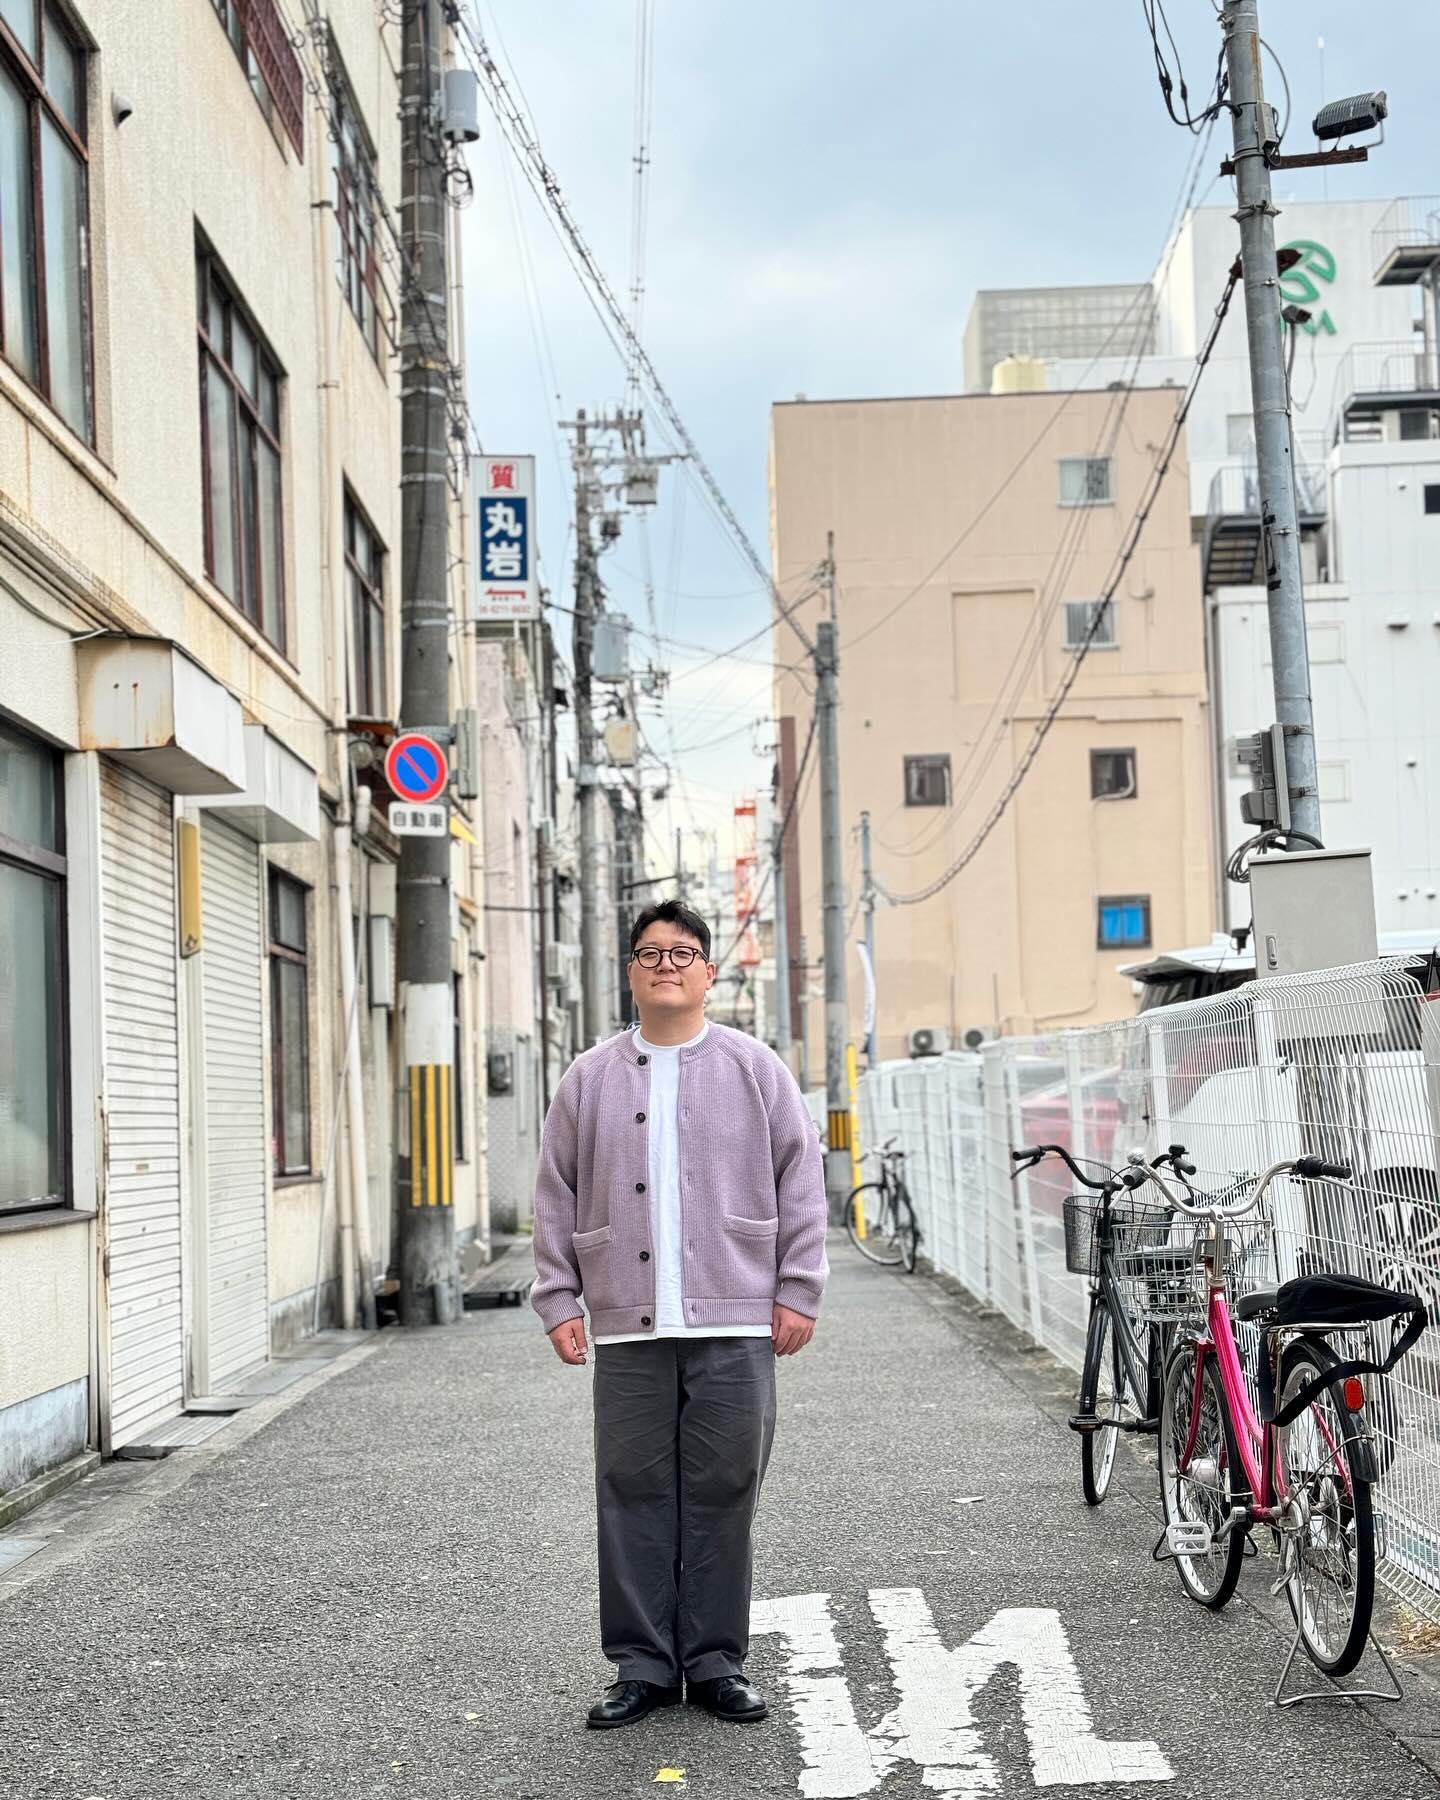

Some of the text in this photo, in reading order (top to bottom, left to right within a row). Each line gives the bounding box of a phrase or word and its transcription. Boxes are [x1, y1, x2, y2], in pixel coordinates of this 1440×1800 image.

[491, 464, 514, 490] 質
[484, 501, 522, 578] 丸岩
[393, 811, 442, 829] 自動車
